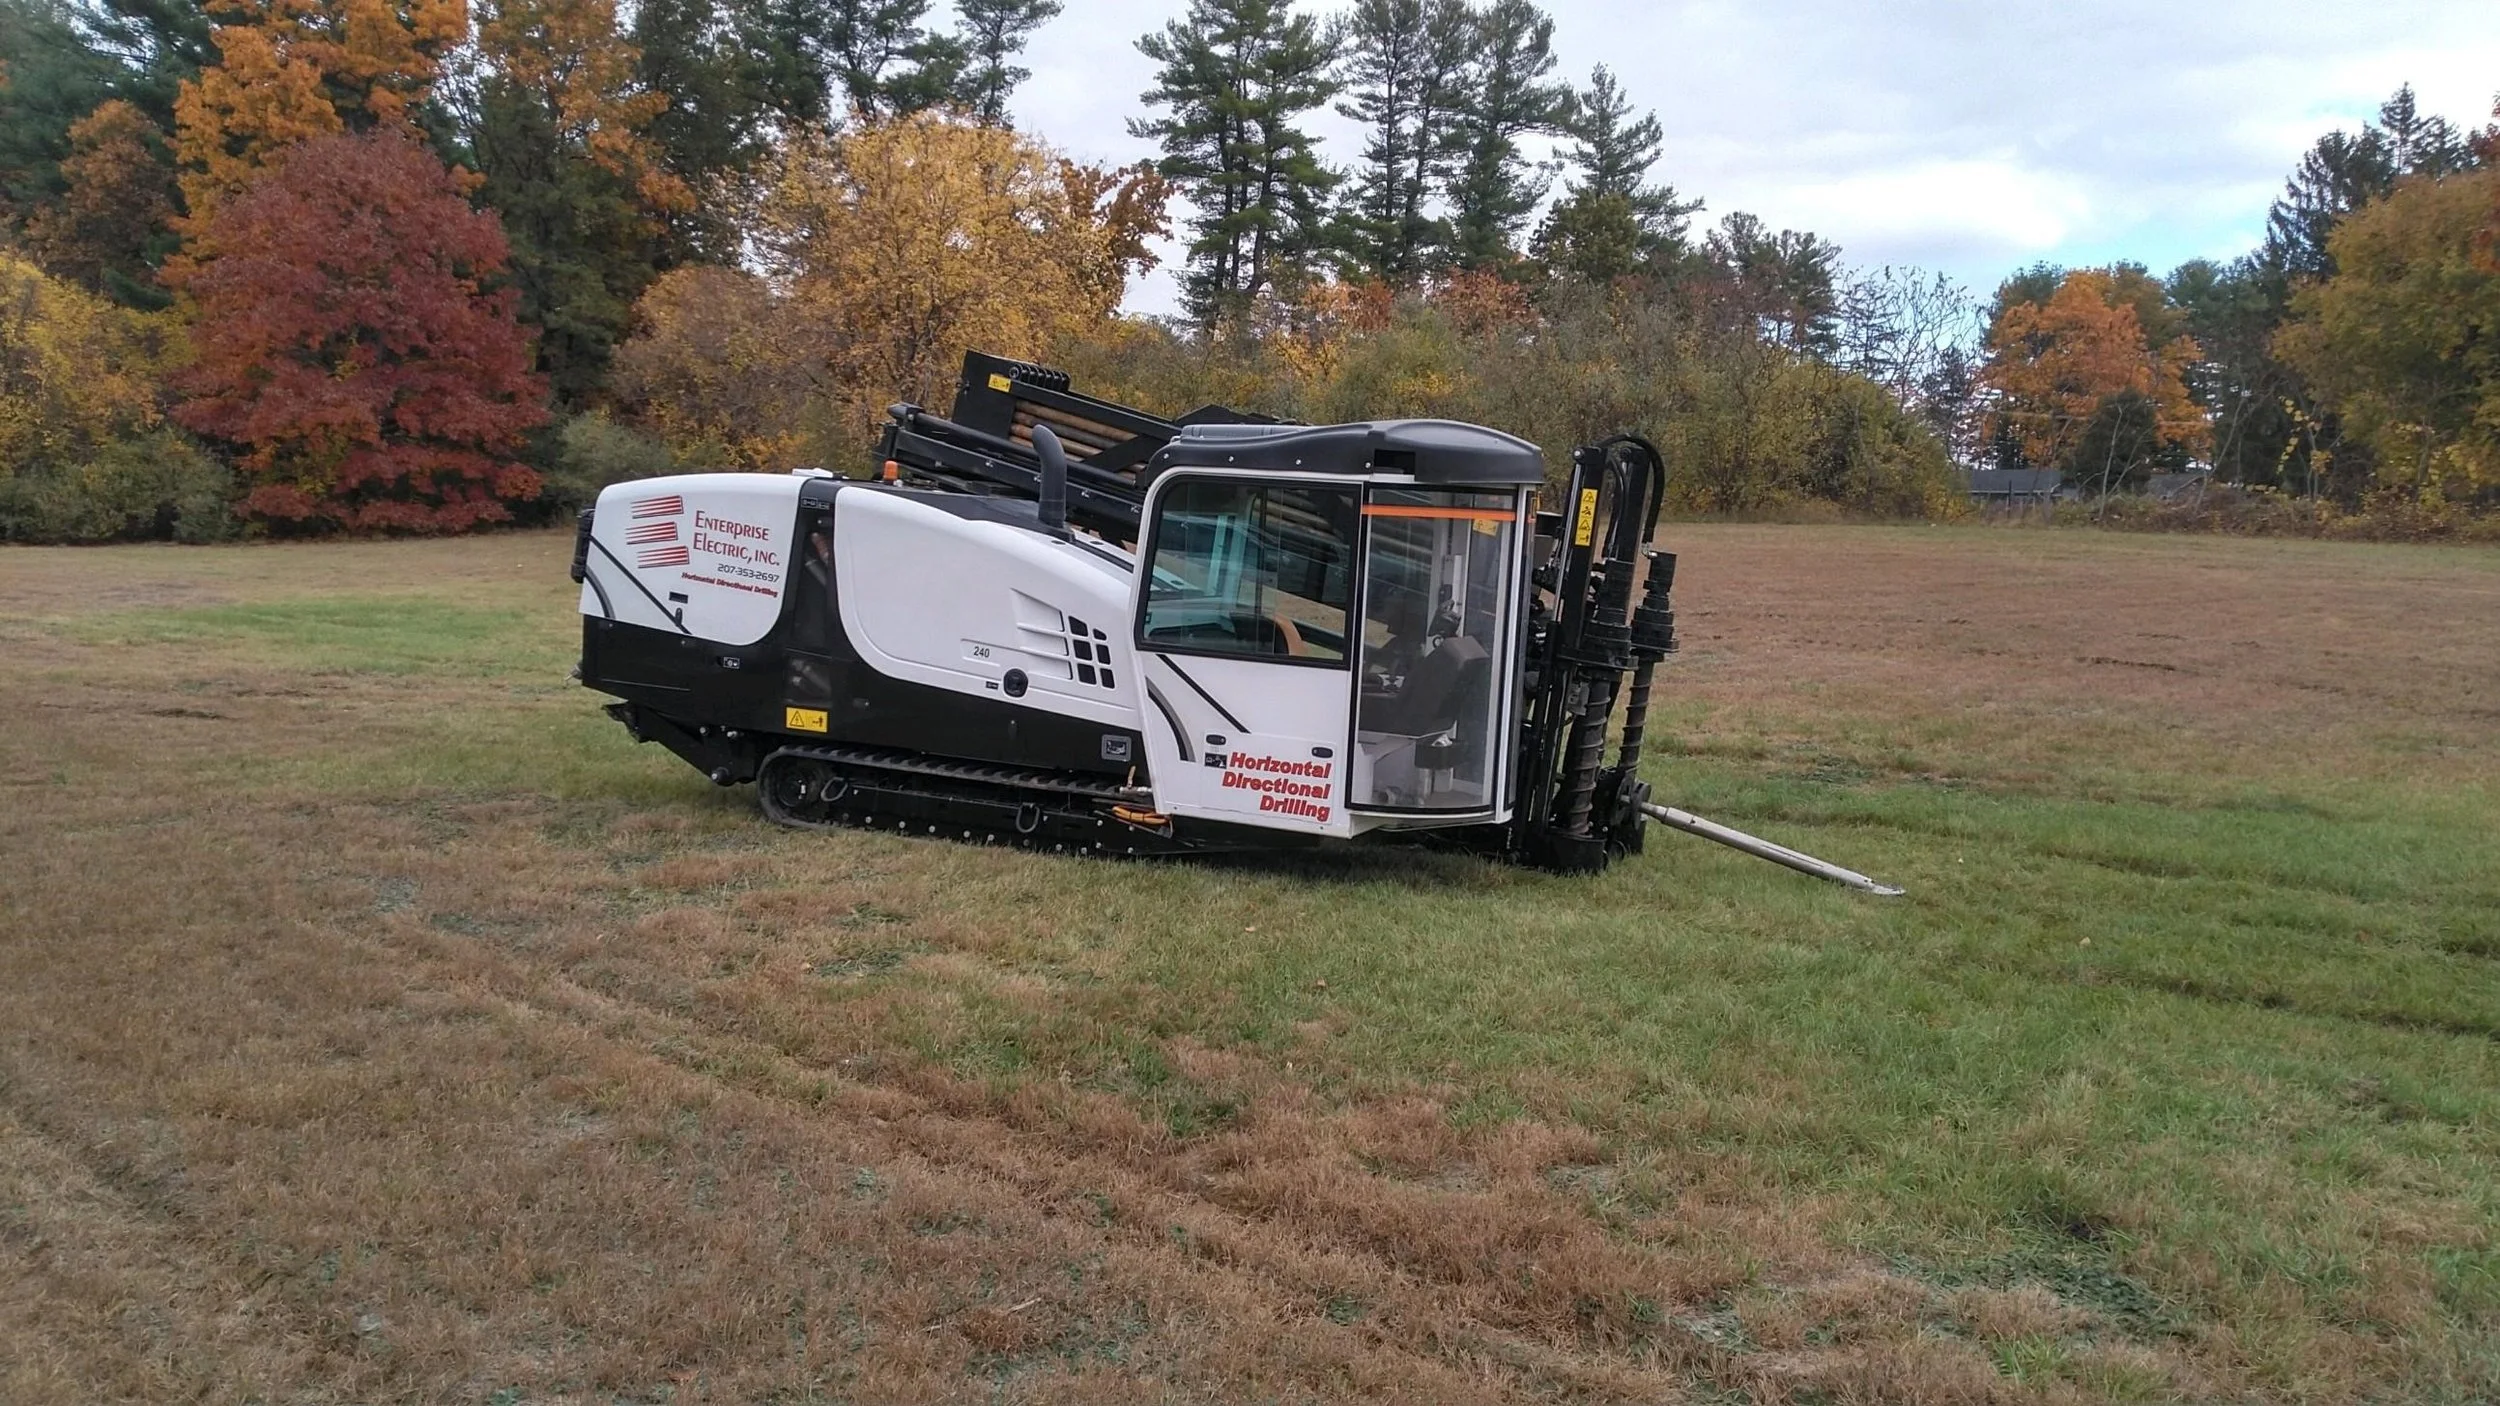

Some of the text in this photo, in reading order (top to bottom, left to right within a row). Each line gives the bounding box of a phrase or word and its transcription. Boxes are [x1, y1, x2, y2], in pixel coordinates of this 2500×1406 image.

[681, 572, 778, 598] Horizontal Directional Drilling
[717, 563, 780, 583] 207-353-2697
[973, 646, 990, 658] 240
[1229, 752, 1331, 779] Horizontal
[1222, 771, 1331, 799] Directional
[1259, 795, 1330, 822] Drilling
